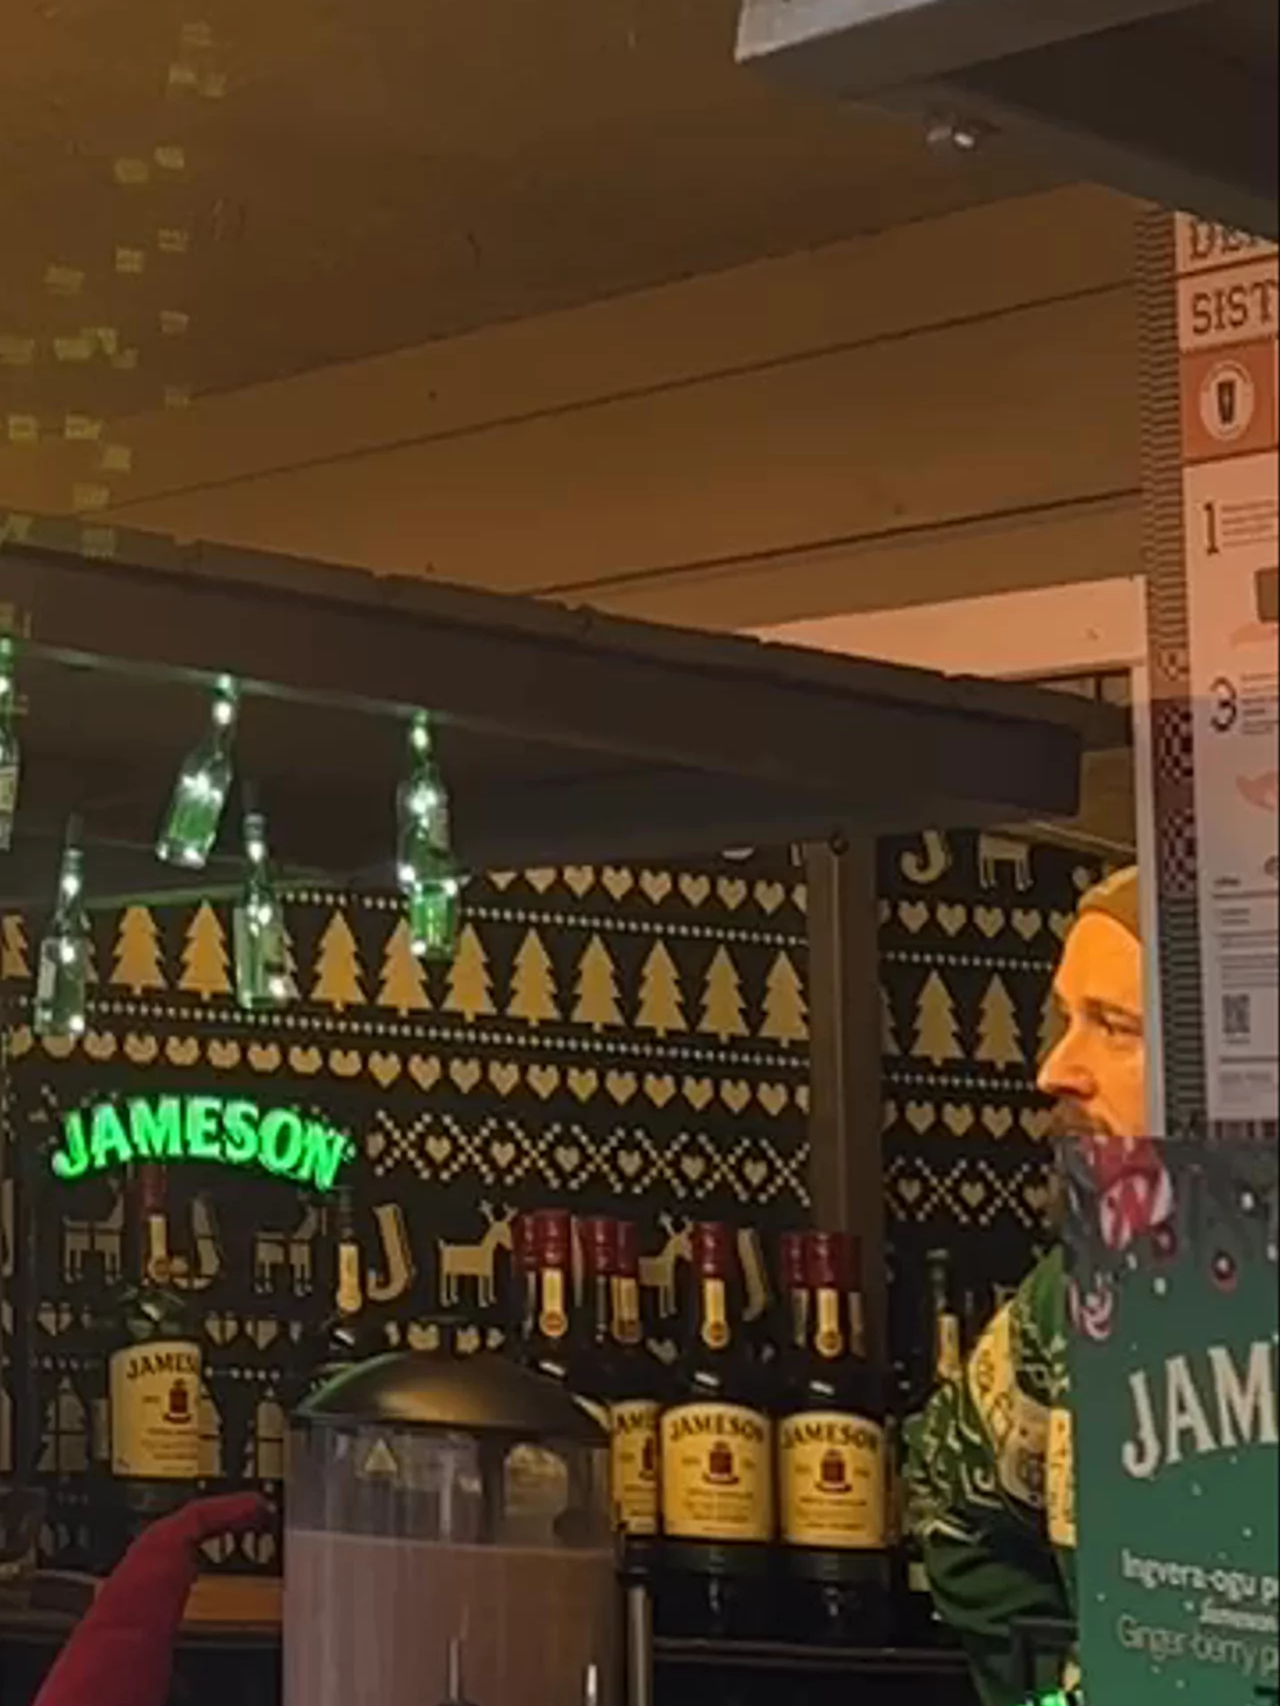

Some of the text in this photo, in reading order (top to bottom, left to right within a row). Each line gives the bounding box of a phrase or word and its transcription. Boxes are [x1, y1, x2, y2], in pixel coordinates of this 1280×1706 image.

[1210, 675, 1238, 733] 3
[51, 1093, 348, 1192] JAMESON
[1121, 1340, 1278, 1478] JAM
